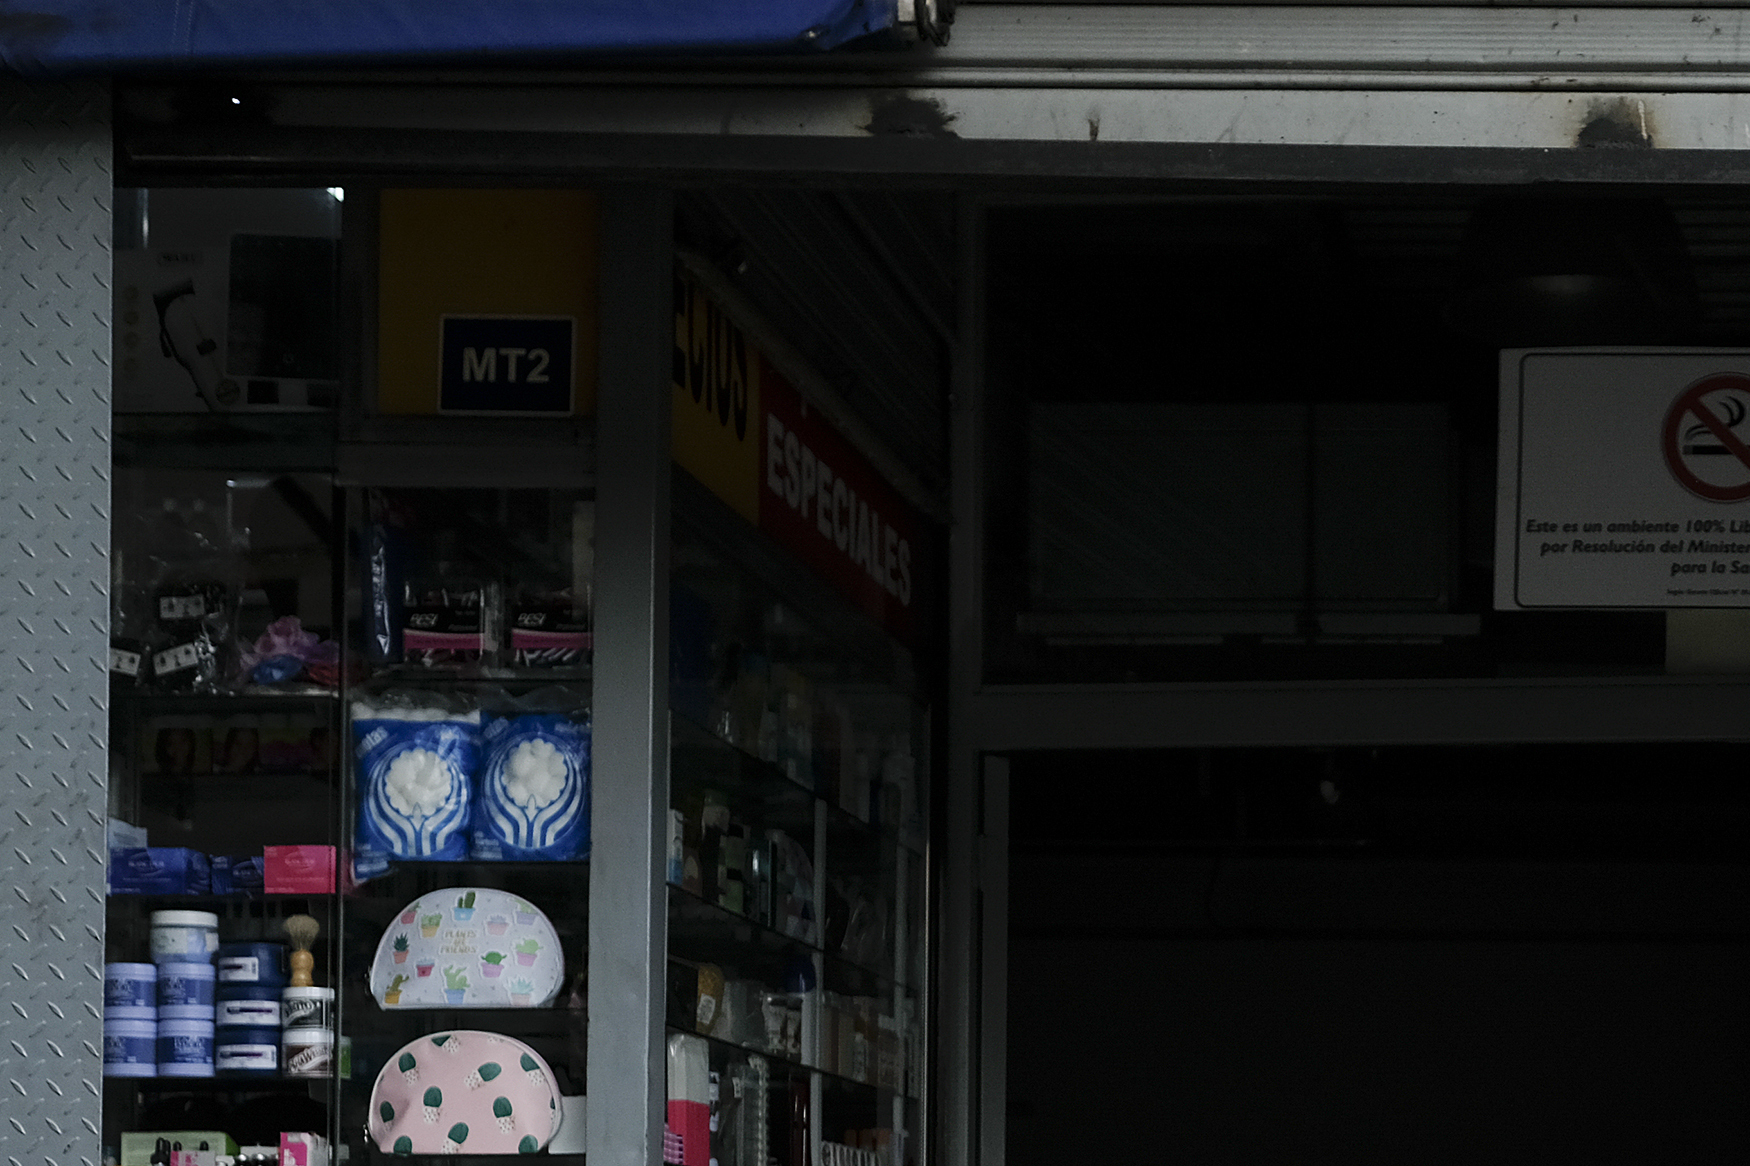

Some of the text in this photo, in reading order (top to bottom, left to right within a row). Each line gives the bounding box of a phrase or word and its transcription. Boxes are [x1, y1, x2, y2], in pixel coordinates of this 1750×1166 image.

[462, 346, 550, 384] MT2
[767, 412, 912, 607] ESPECIALES
[1525, 519, 1558, 533] Este
[1562, 522, 1579, 533] es
[1582, 522, 1603, 533] un
[1606, 519, 1679, 534] ambiente
[1685, 519, 1725, 534] 100%
[1540, 541, 1568, 557] por
[1572, 539, 1656, 553] Resolución
[1659, 539, 1684, 553] del
[1670, 561, 1707, 577] para
[1711, 560, 1726, 573] la
